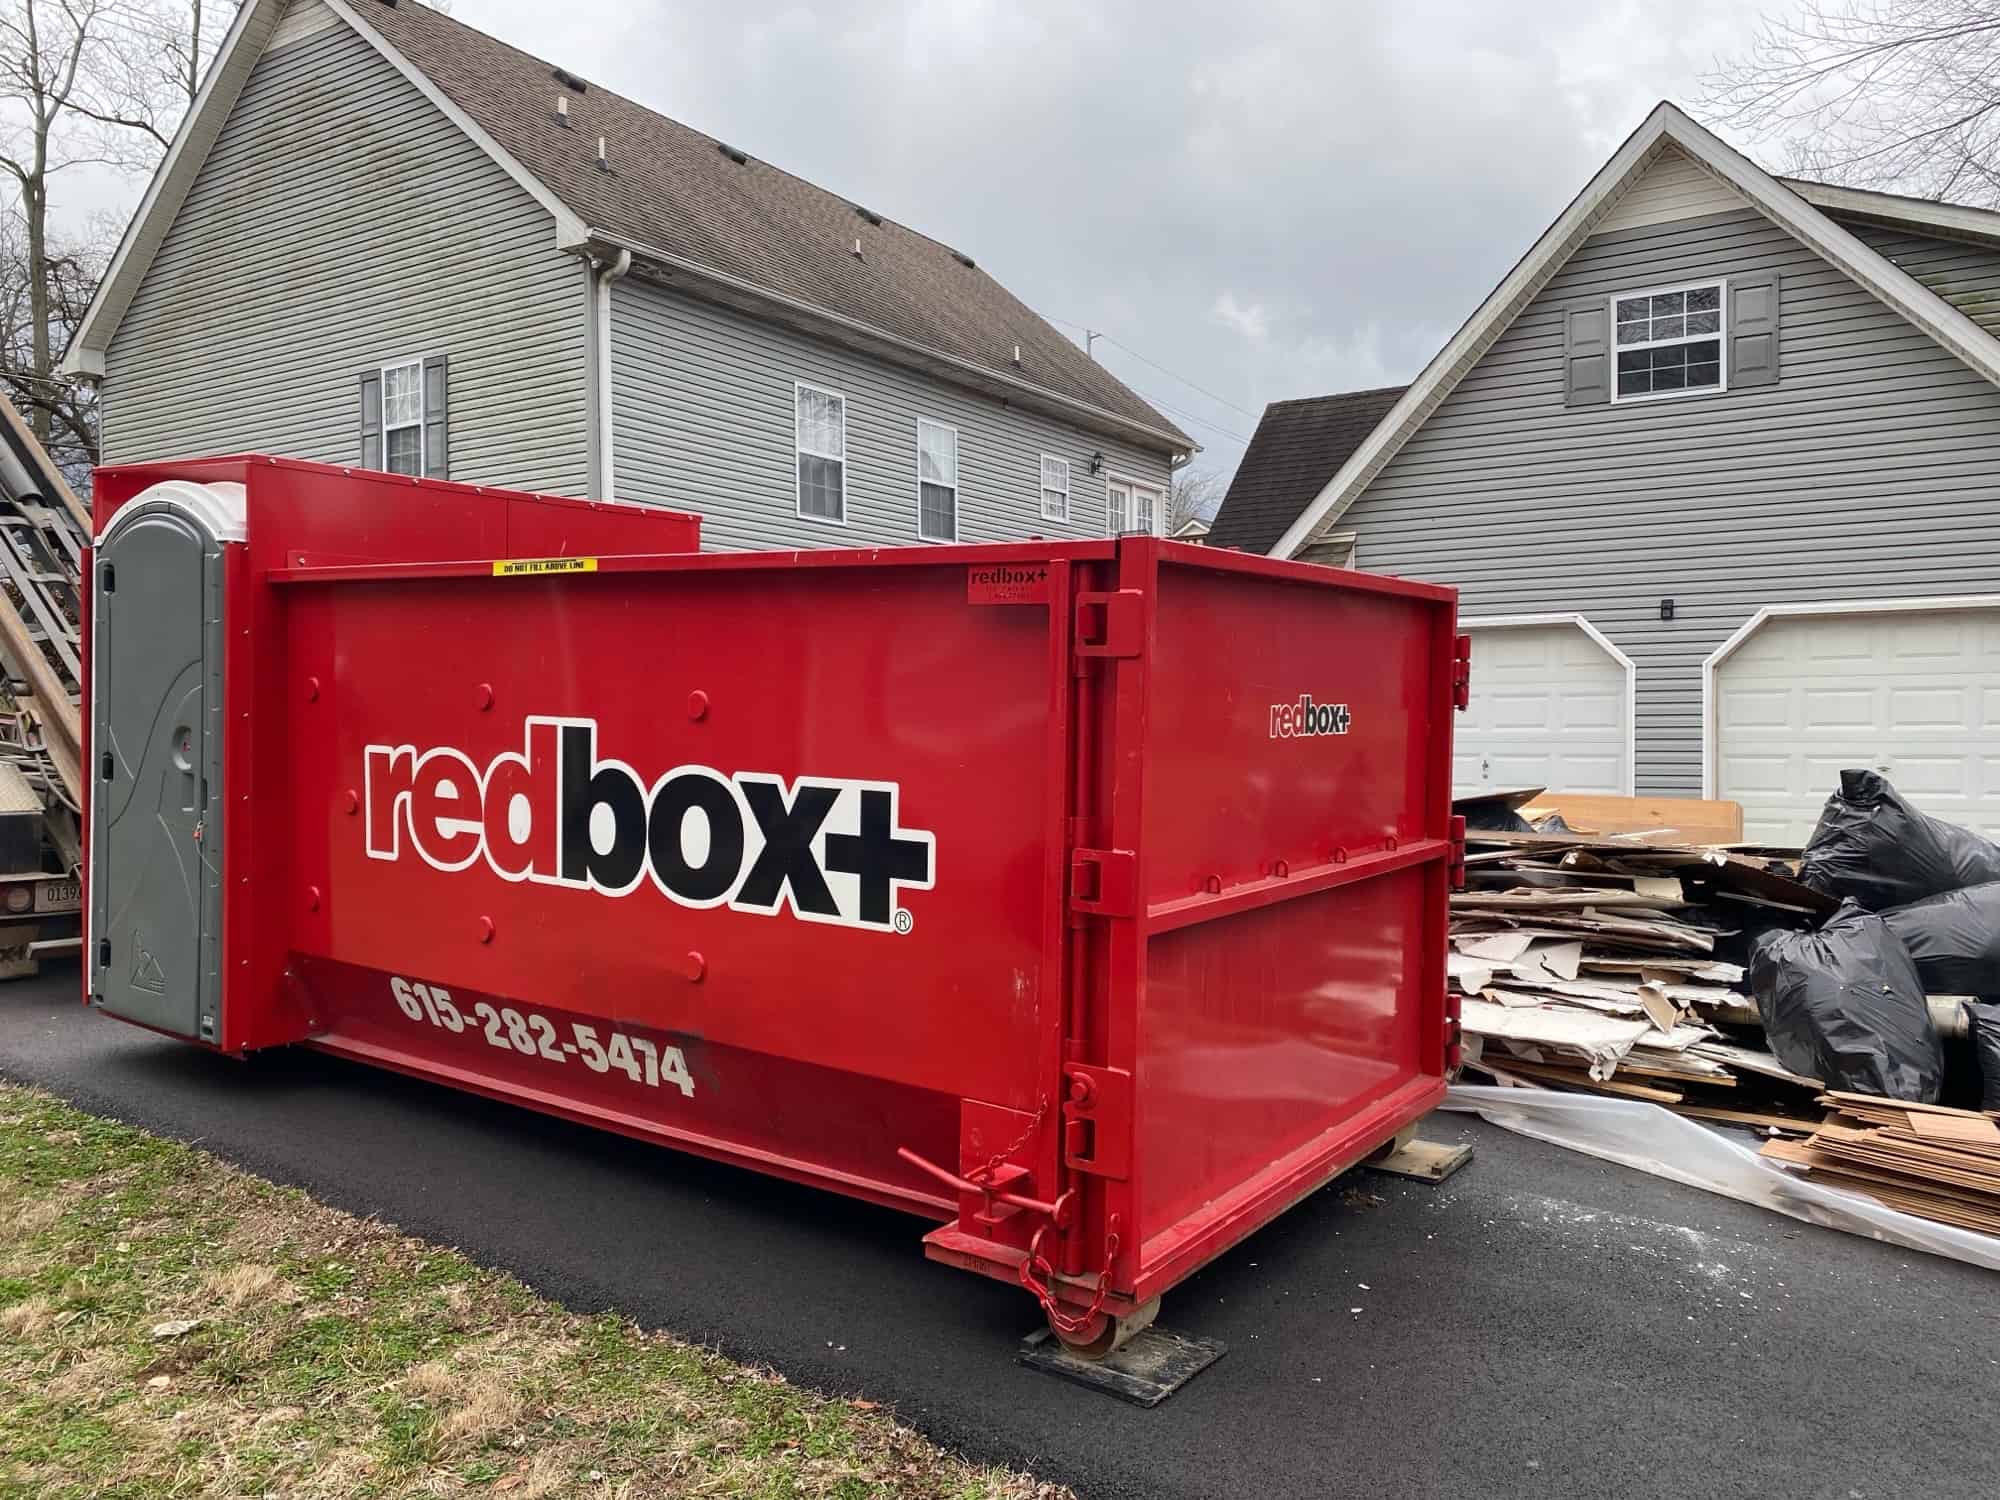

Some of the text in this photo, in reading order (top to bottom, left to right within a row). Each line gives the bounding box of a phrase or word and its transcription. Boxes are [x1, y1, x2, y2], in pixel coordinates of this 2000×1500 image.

[504, 561, 584, 573] DO NOT FILL ABOVE LINE
